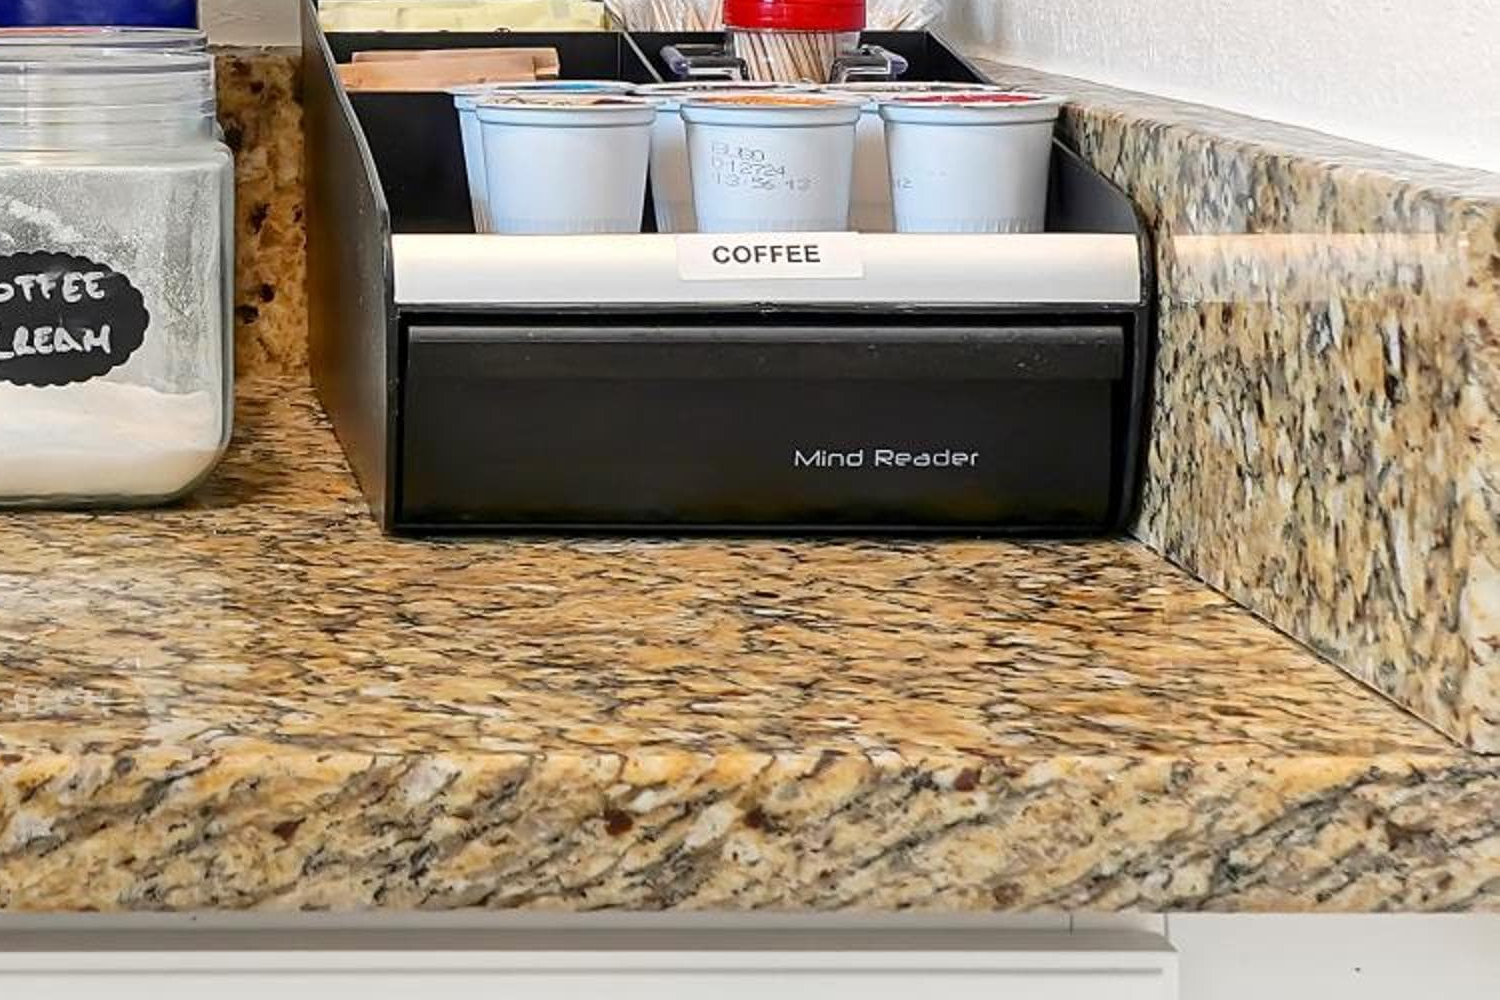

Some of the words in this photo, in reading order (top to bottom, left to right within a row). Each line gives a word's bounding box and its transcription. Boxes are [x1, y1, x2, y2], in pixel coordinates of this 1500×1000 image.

[711, 244, 822, 264] COFFEE
[794, 449, 864, 467] Mind
[874, 449, 980, 467] Reader
